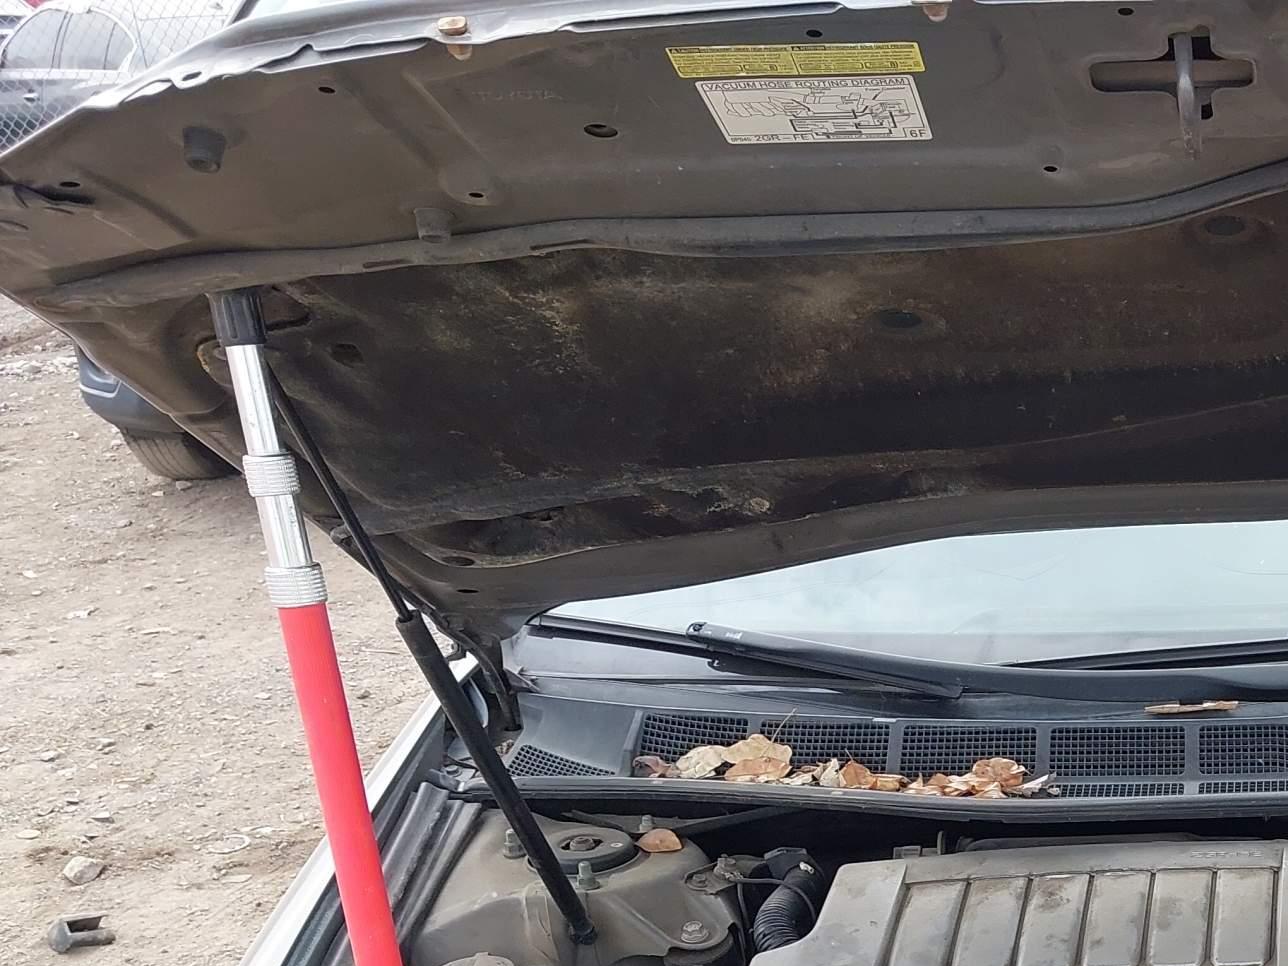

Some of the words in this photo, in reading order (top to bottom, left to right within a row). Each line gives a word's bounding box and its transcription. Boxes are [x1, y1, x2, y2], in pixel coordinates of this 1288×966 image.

[707, 83, 756, 91] VACUUM
[760, 81, 792, 89] HOSE
[795, 80, 849, 89] ROUTING
[852, 78, 906, 87] DIAGRAM
[910, 129, 927, 138] 6F
